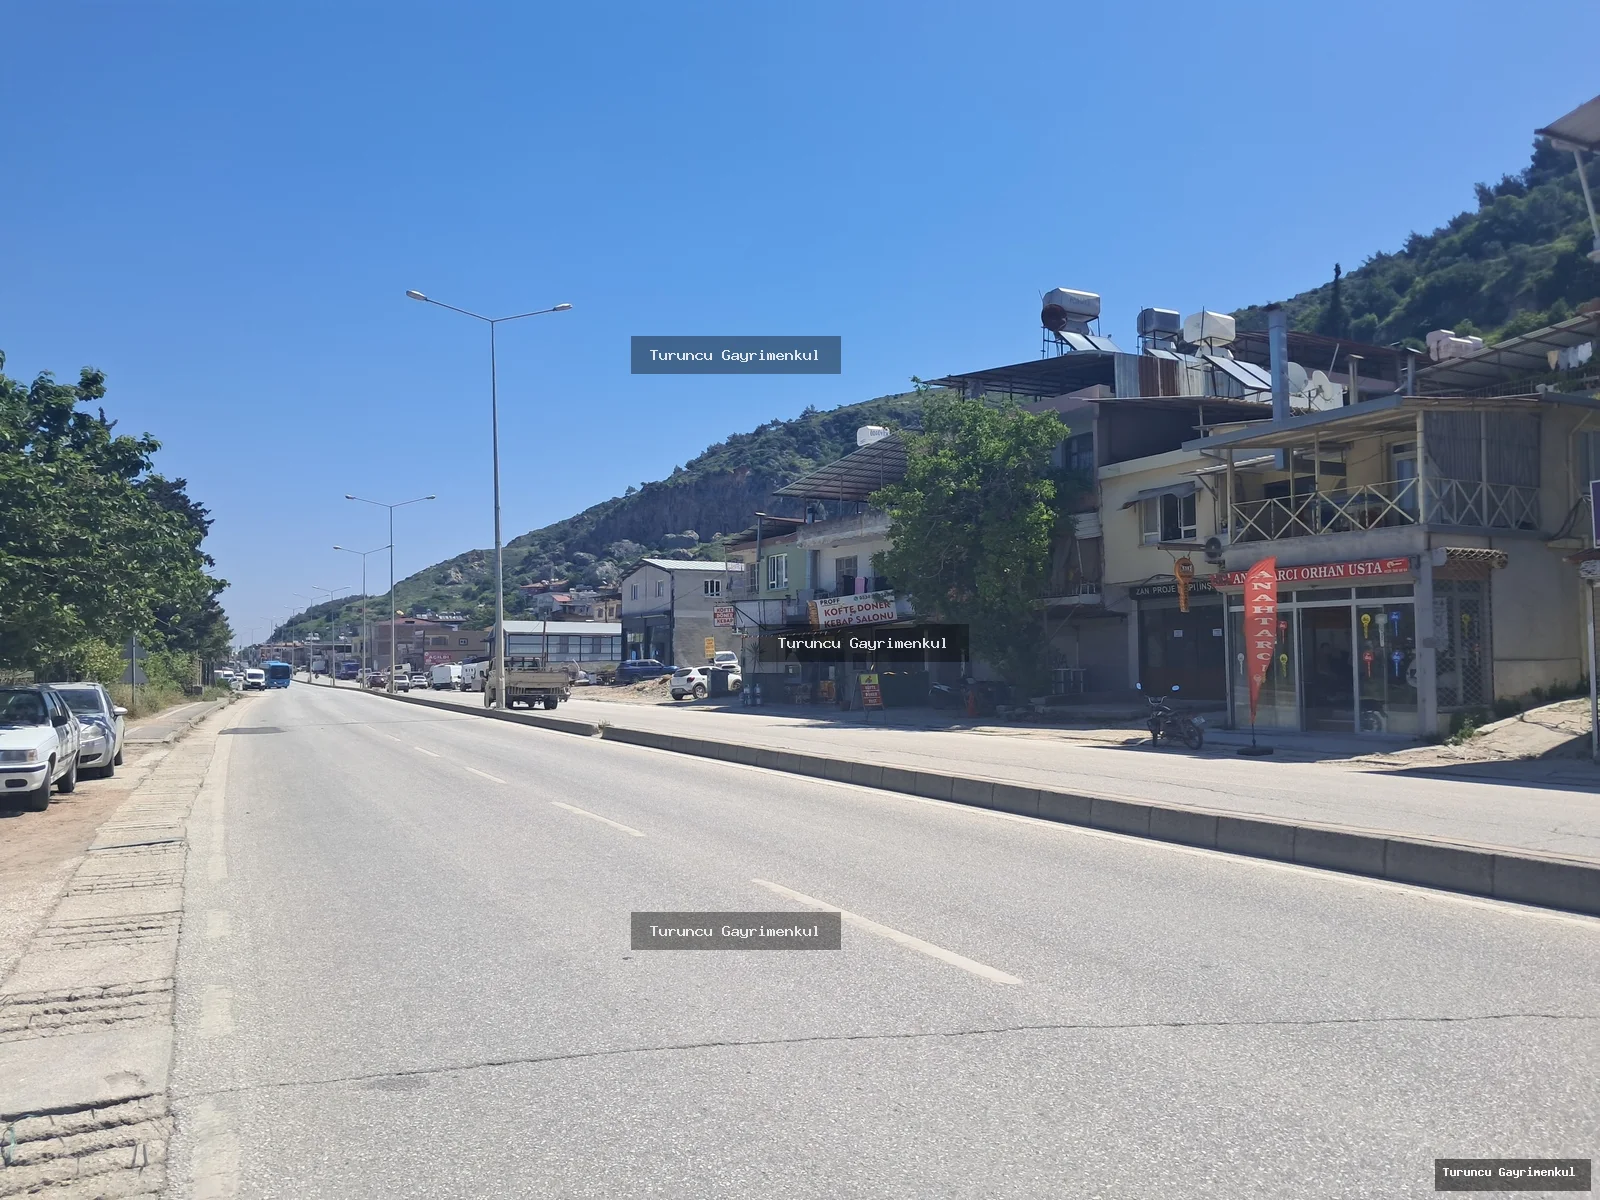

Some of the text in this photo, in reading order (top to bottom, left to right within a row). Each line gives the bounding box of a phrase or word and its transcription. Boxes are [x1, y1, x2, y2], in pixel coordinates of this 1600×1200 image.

[1301, 565, 1344, 579] ORHAN
[1349, 562, 1382, 575] USTA
[1153, 585, 1176, 594] PROJE
[824, 612, 894, 628] KEBAP SALONU
[1251, 571, 1275, 672] ANAHTARCI
